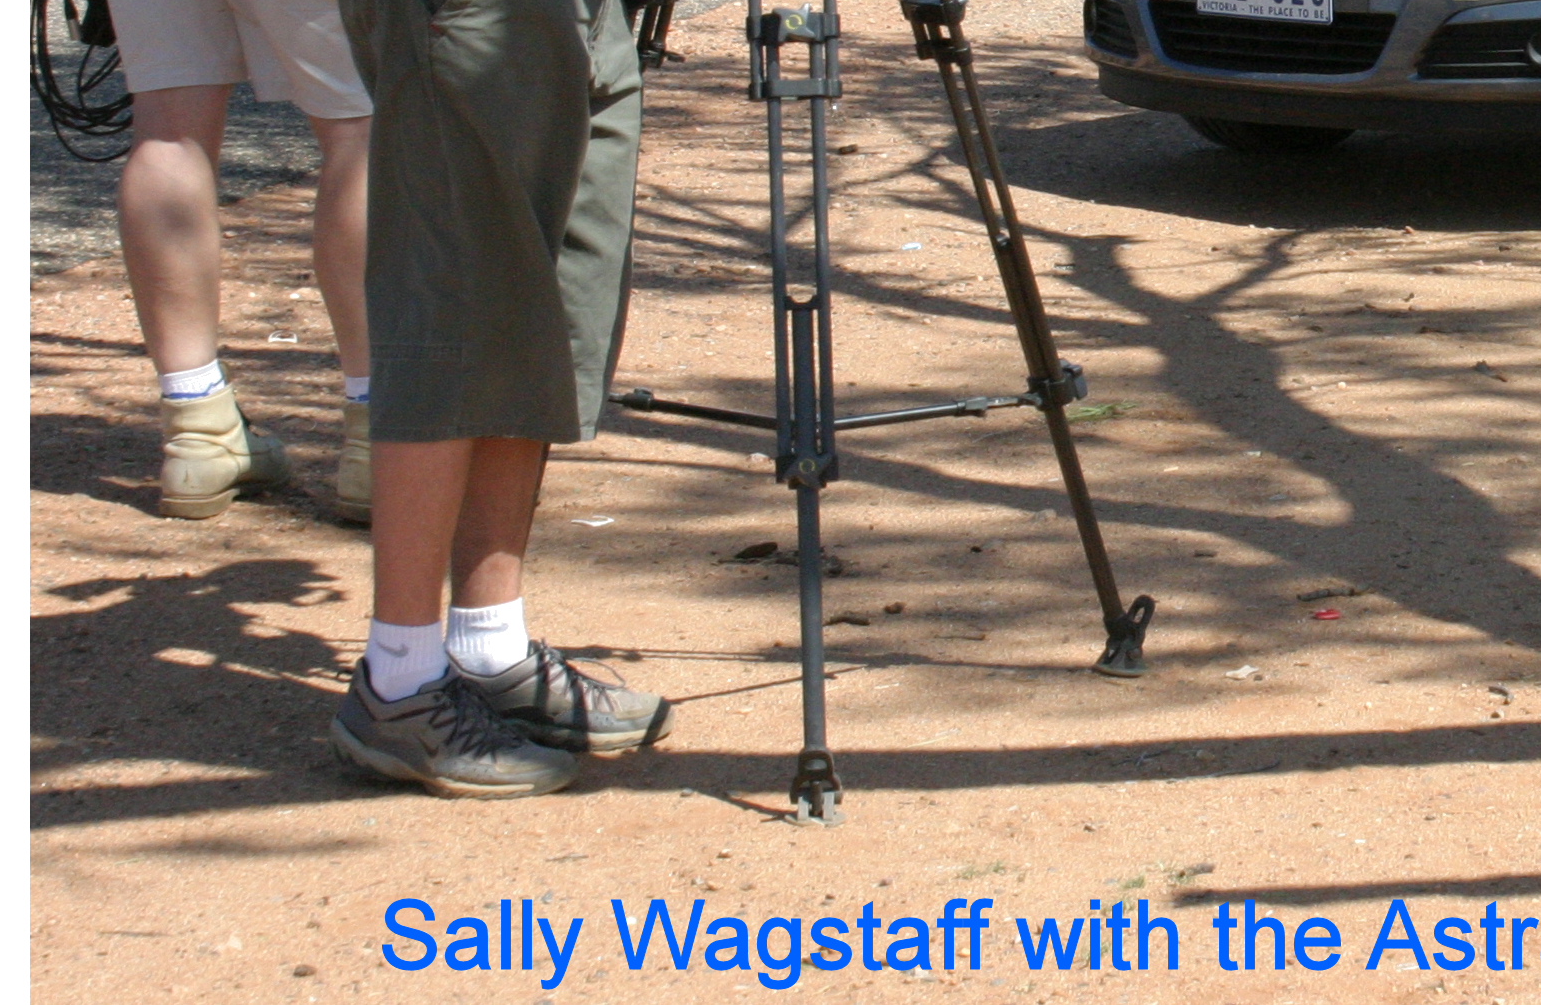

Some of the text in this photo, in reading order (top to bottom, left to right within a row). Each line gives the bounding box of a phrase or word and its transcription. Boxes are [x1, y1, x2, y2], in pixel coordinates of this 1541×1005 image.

[1202, 1, 1237, 12] VICTORIA
[1249, 5, 1264, 14] THE
[1268, 6, 1293, 17] PLACE
[1298, 8, 1309, 18] TO
[1314, 9, 1324, 19] BE
